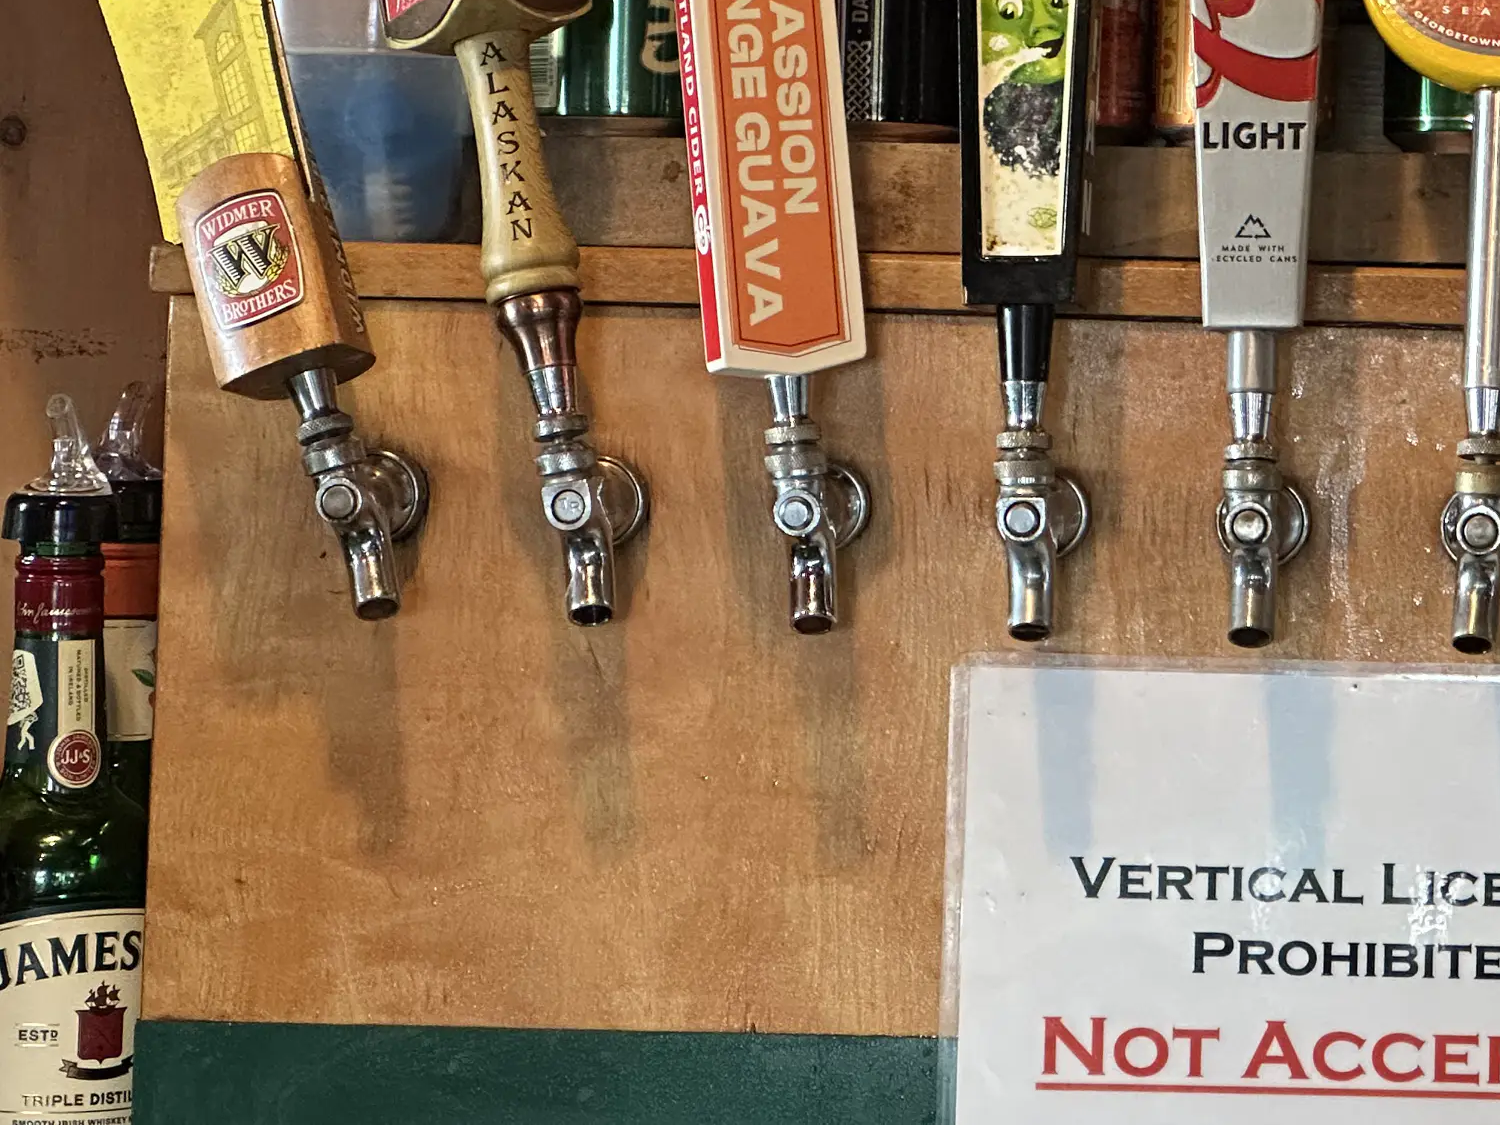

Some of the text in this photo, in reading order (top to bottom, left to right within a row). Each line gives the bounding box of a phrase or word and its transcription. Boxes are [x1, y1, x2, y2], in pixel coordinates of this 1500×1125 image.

[479, 40, 534, 242] ALASKAN
[686, 103, 704, 197] CIDER
[1203, 121, 1307, 150] LIGHT
[200, 199, 273, 241] WIDMER
[734, 112, 785, 327] GUAVA
[210, 223, 281, 283] W
[1212, 255, 1298, 263] ECYCLED CANS
[1221, 244, 1285, 252] MADE WITH
[222, 278, 298, 324] BROTHERS
[22, 1093, 84, 1107] TRIPLE
